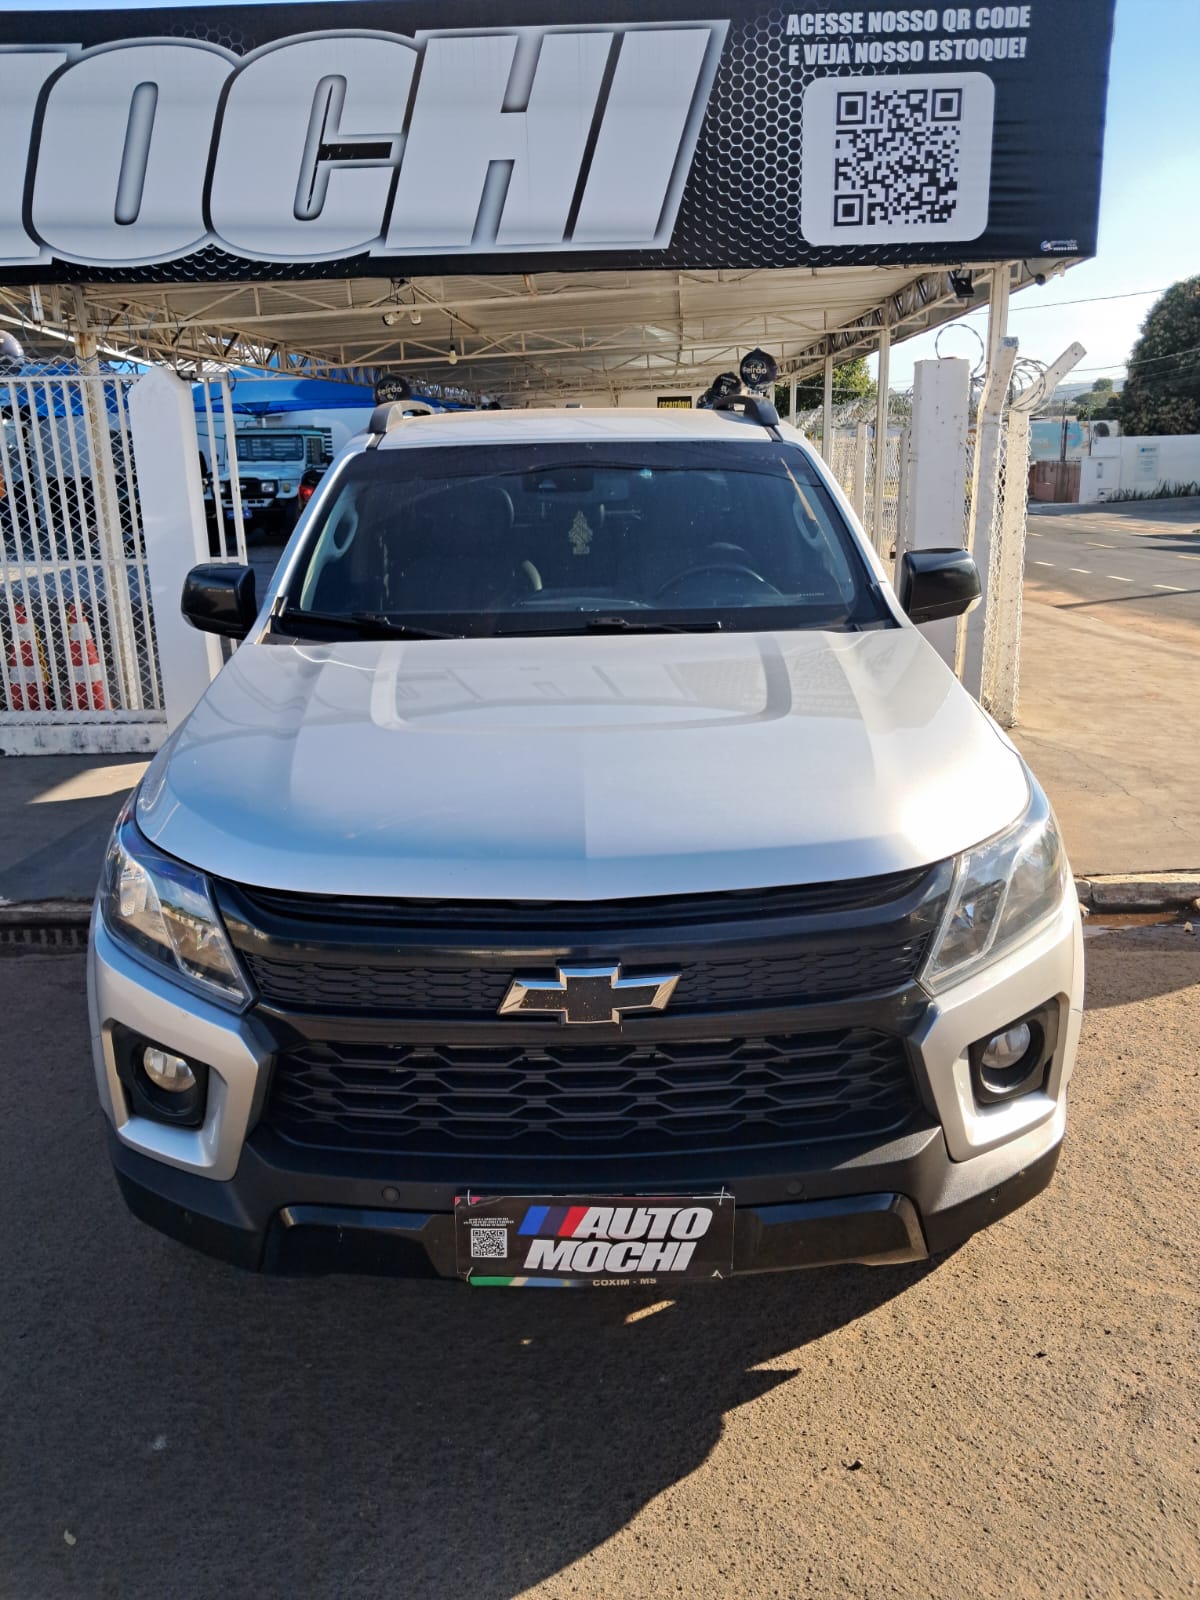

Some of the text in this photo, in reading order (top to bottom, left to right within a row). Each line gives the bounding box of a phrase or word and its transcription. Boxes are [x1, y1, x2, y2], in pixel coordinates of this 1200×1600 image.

[786, 6, 1032, 36] ACESSE NOSSO QR CODE
[788, 37, 1027, 66] E VEJA NOSSO ESTOQUE!
[571, 1206, 714, 1240] AUTO
[523, 1239, 698, 1273] MOCHI
[592, 1279, 630, 1287] COXIM
[640, 1278, 657, 1286] MS
